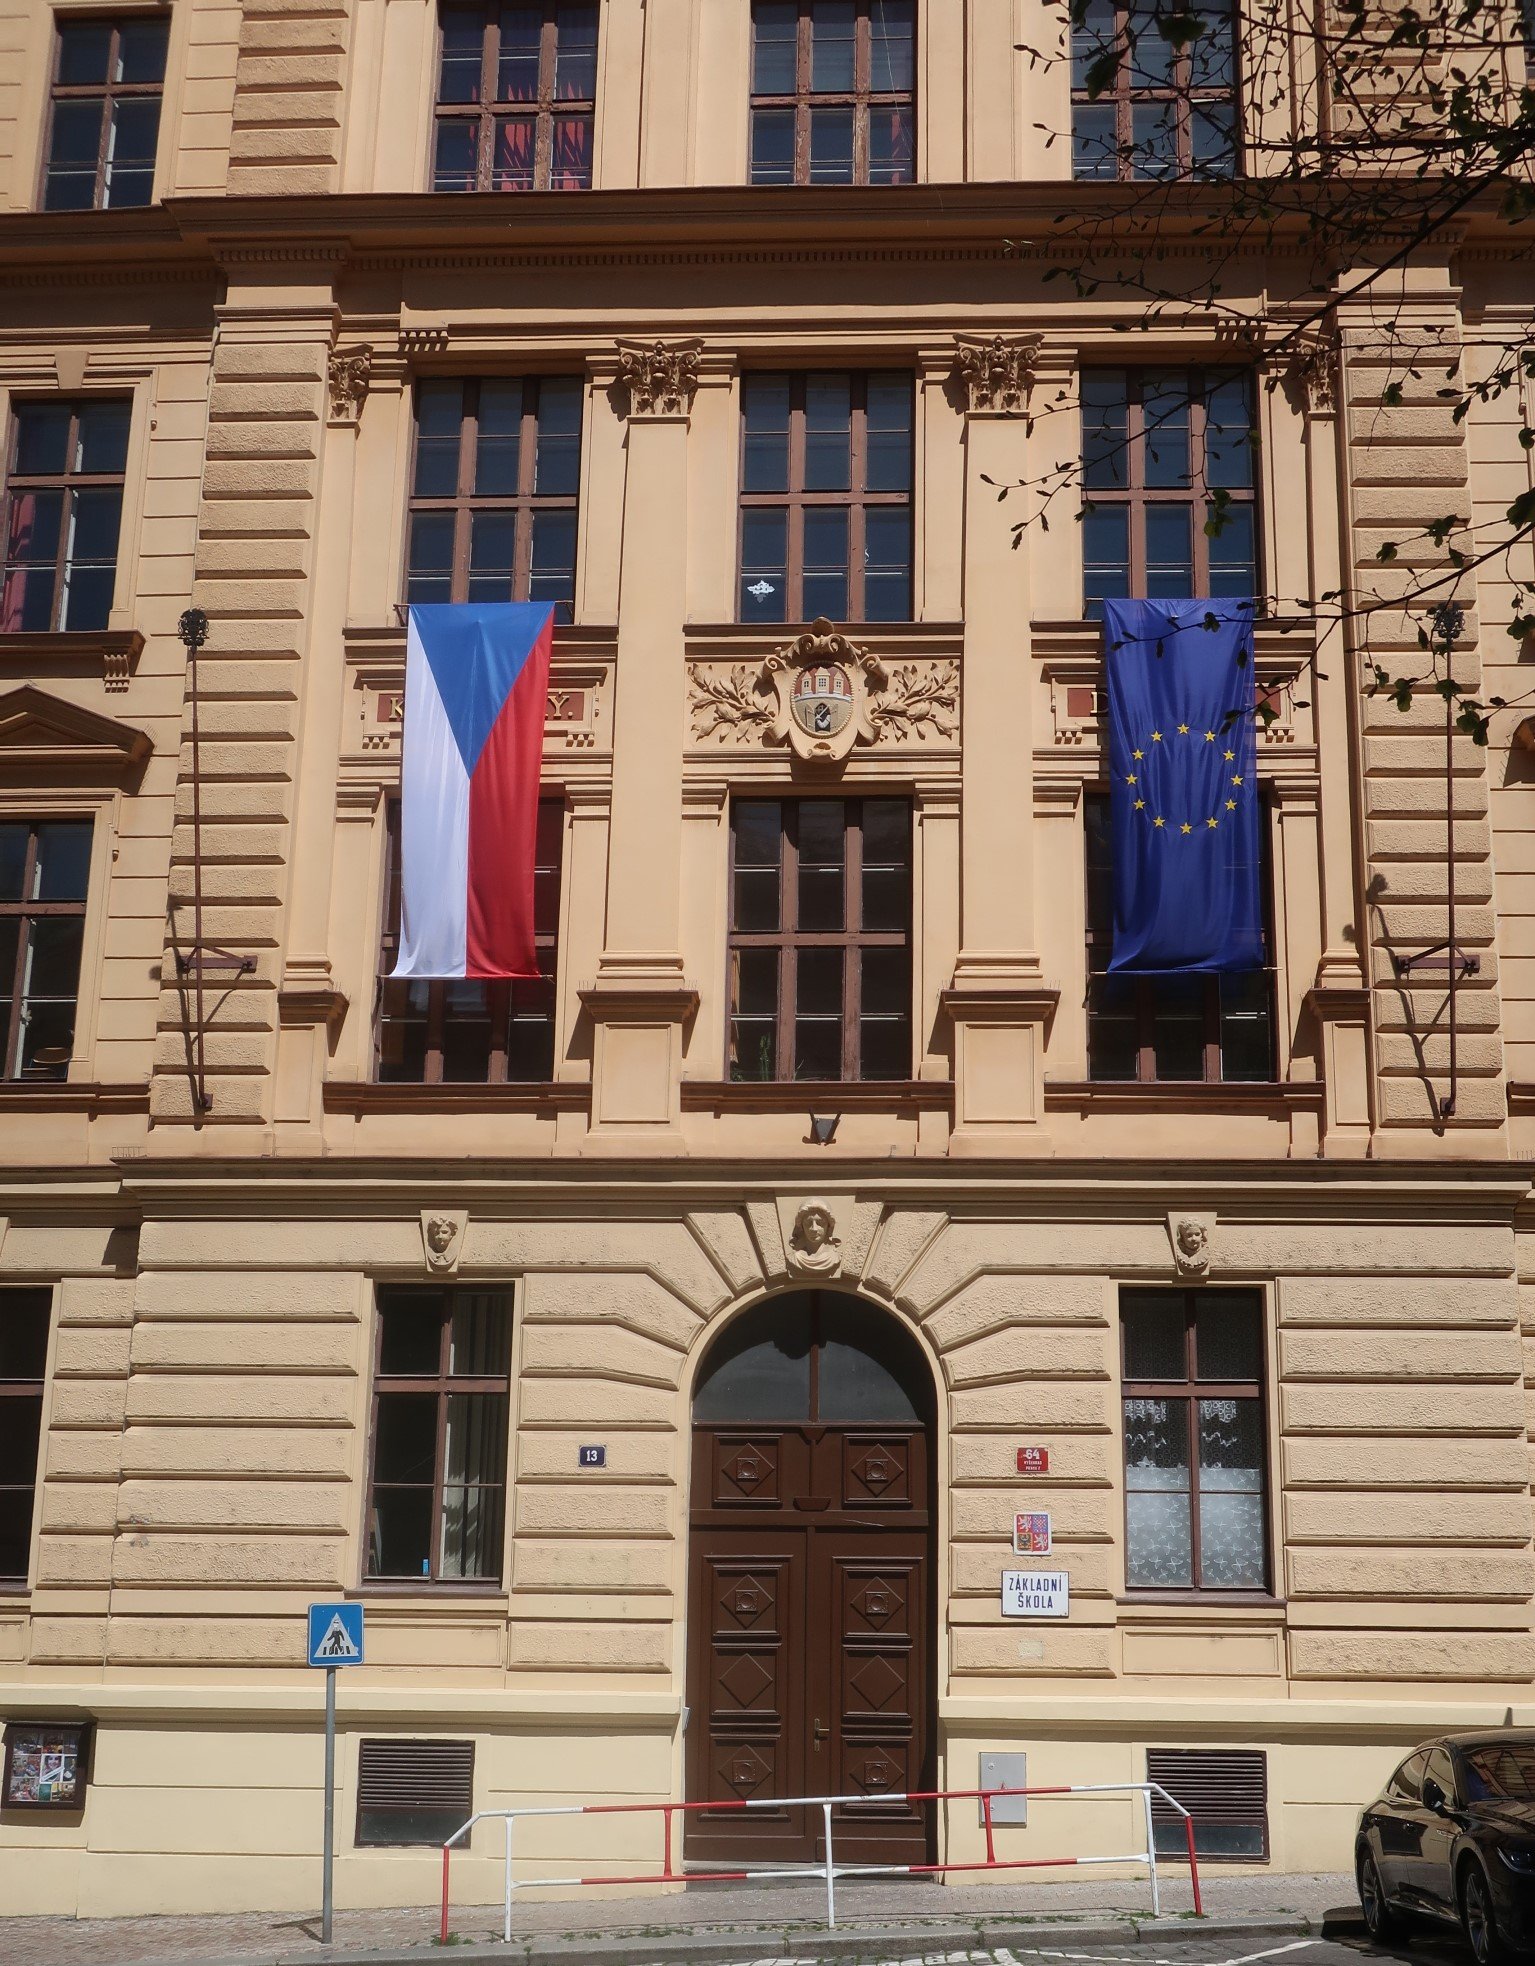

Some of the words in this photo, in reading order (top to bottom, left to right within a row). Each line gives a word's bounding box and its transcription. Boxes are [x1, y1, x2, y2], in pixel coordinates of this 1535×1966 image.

[586, 1450, 598, 1462] 13
[1025, 1448, 1040, 1460] 64
[1009, 1574, 1062, 1592] ZÁKLADNÍ
[1017, 1592, 1053, 1609] ŠKOLA
